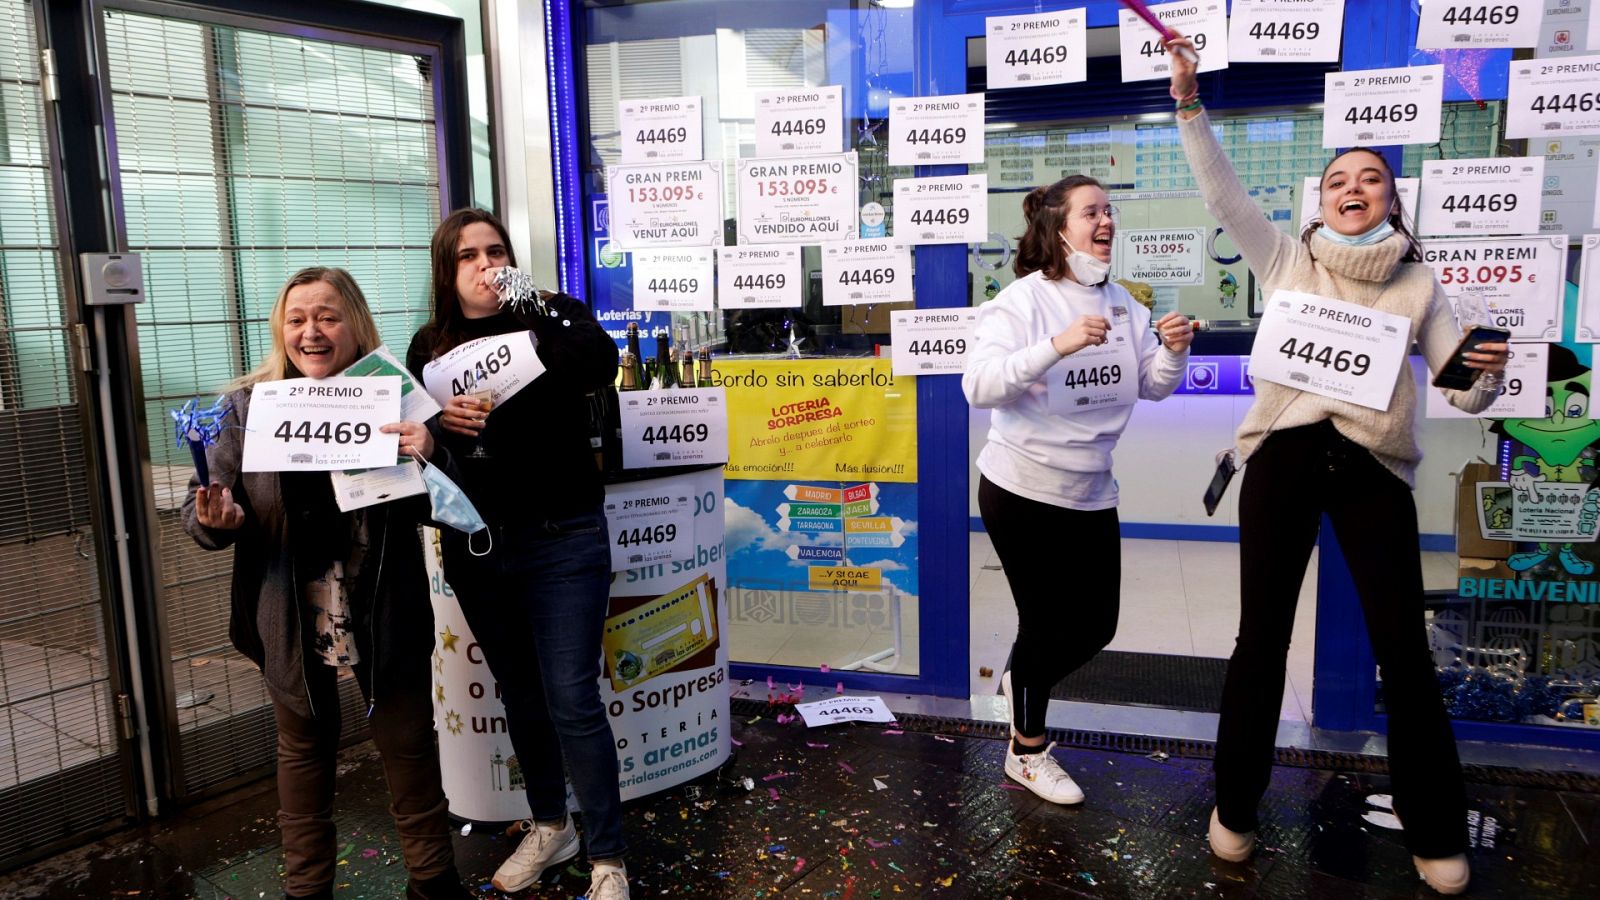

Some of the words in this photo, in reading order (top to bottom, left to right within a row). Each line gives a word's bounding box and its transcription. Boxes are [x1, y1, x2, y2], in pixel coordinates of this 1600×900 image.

[1159, 6, 1198, 20] PREMIO
[1442, 5, 1519, 26] 44469
[1023, 19, 1060, 30] PREMIO
[1249, 22, 1320, 40] 44469
[1140, 33, 1207, 58] 449
[1004, 45, 1068, 67] 44469
[1368, 75, 1411, 86] PREMIO
[787, 93, 820, 104] PREMIO
[925, 102, 960, 111] PREMIO
[650, 103, 681, 113] PREMIO
[1344, 103, 1418, 125] 44469
[771, 118, 826, 137] 44469
[636, 127, 687, 145] 44469
[906, 127, 966, 145] 44469
[625, 172, 661, 184] GRAN
[666, 170, 702, 182] PREMI
[749, 165, 788, 178] GRAN
[792, 162, 842, 176] PREMIO
[1467, 165, 1511, 175] PREMIO
[628, 185, 694, 203] 153.095
[697, 192, 704, 200] €
[757, 178, 828, 197] 153.095
[831, 186, 838, 194] €
[928, 183, 963, 192] PREMIO
[1441, 193, 1518, 213] 44469
[910, 208, 970, 226] 44469
[632, 228, 667, 239] VENUT
[754, 223, 806, 234] VENDIDO
[809, 219, 840, 232] AQUÍ
[1130, 233, 1158, 243] GRAN
[1160, 233, 1195, 242] PREMIO
[749, 250, 780, 258] PREMIO
[854, 244, 888, 253] PREMIO
[1134, 243, 1185, 255] 153.095
[1424, 249, 1477, 263] GRAN
[1483, 247, 1537, 261] PREMI
[662, 255, 692, 263] PREMIO
[733, 273, 786, 290] 44469
[838, 268, 895, 286] 44469
[1131, 271, 1168, 279] VENDIDO
[1170, 269, 1191, 278] AQUÍ
[1440, 264, 1523, 285] 53.095
[1527, 274, 1536, 283] €
[648, 278, 699, 294] 44469
[596, 308, 642, 321] Loterías
[644, 311, 652, 322] y
[925, 314, 959, 323] PREMIO
[1318, 307, 1372, 328] PREMIO
[1496, 314, 1524, 327] QUÍ
[908, 338, 967, 356] 44469
[1279, 337, 1371, 377] 44469
[451, 344, 512, 397] 44469
[711, 369, 768, 388] Gordo
[775, 370, 805, 387] sin
[812, 367, 895, 388] saberlo!
[1064, 364, 1121, 390] 44469
[308, 386, 363, 398] PREMIO
[660, 395, 699, 405] PREMIO
[771, 397, 830, 417] LOTERIA
[767, 407, 843, 431] SORPRESA
[274, 420, 372, 445] 44469
[642, 423, 708, 445] 44469
[749, 435, 781, 449] Abrelo
[783, 428, 824, 443] despues
[826, 422, 841, 433] del
[844, 416, 876, 431] sorteo
[795, 443, 803, 451] a
[804, 434, 853, 450] celebrarlo
[743, 462, 794, 473] emoción!!!
[835, 463, 859, 473] Más
[861, 463, 905, 474] ilusión!!!
[805, 489, 832, 500] MADRID
[847, 487, 867, 500] BILBAO
[634, 496, 670, 508] PREMIO
[797, 507, 833, 516] ZARAGOZA
[845, 505, 870, 516] JAEN
[796, 521, 834, 530] TARRAGONA
[850, 521, 887, 530] SEVILLA
[617, 523, 677, 549] 44469
[847, 535, 890, 545] PONTEVEDRA
[799, 548, 842, 558] VALENCIA
[835, 570, 846, 579] SI
[847, 571, 870, 579] CAE
[431, 571, 454, 597] de
[1458, 576, 1600, 603] BIENVENI
[632, 666, 725, 713] Sorpresa
[819, 706, 874, 716] 44469
[617, 708, 718, 749] OTERÍA
[643, 726, 718, 767] arenas
[620, 747, 718, 788] erialasarenas.com
